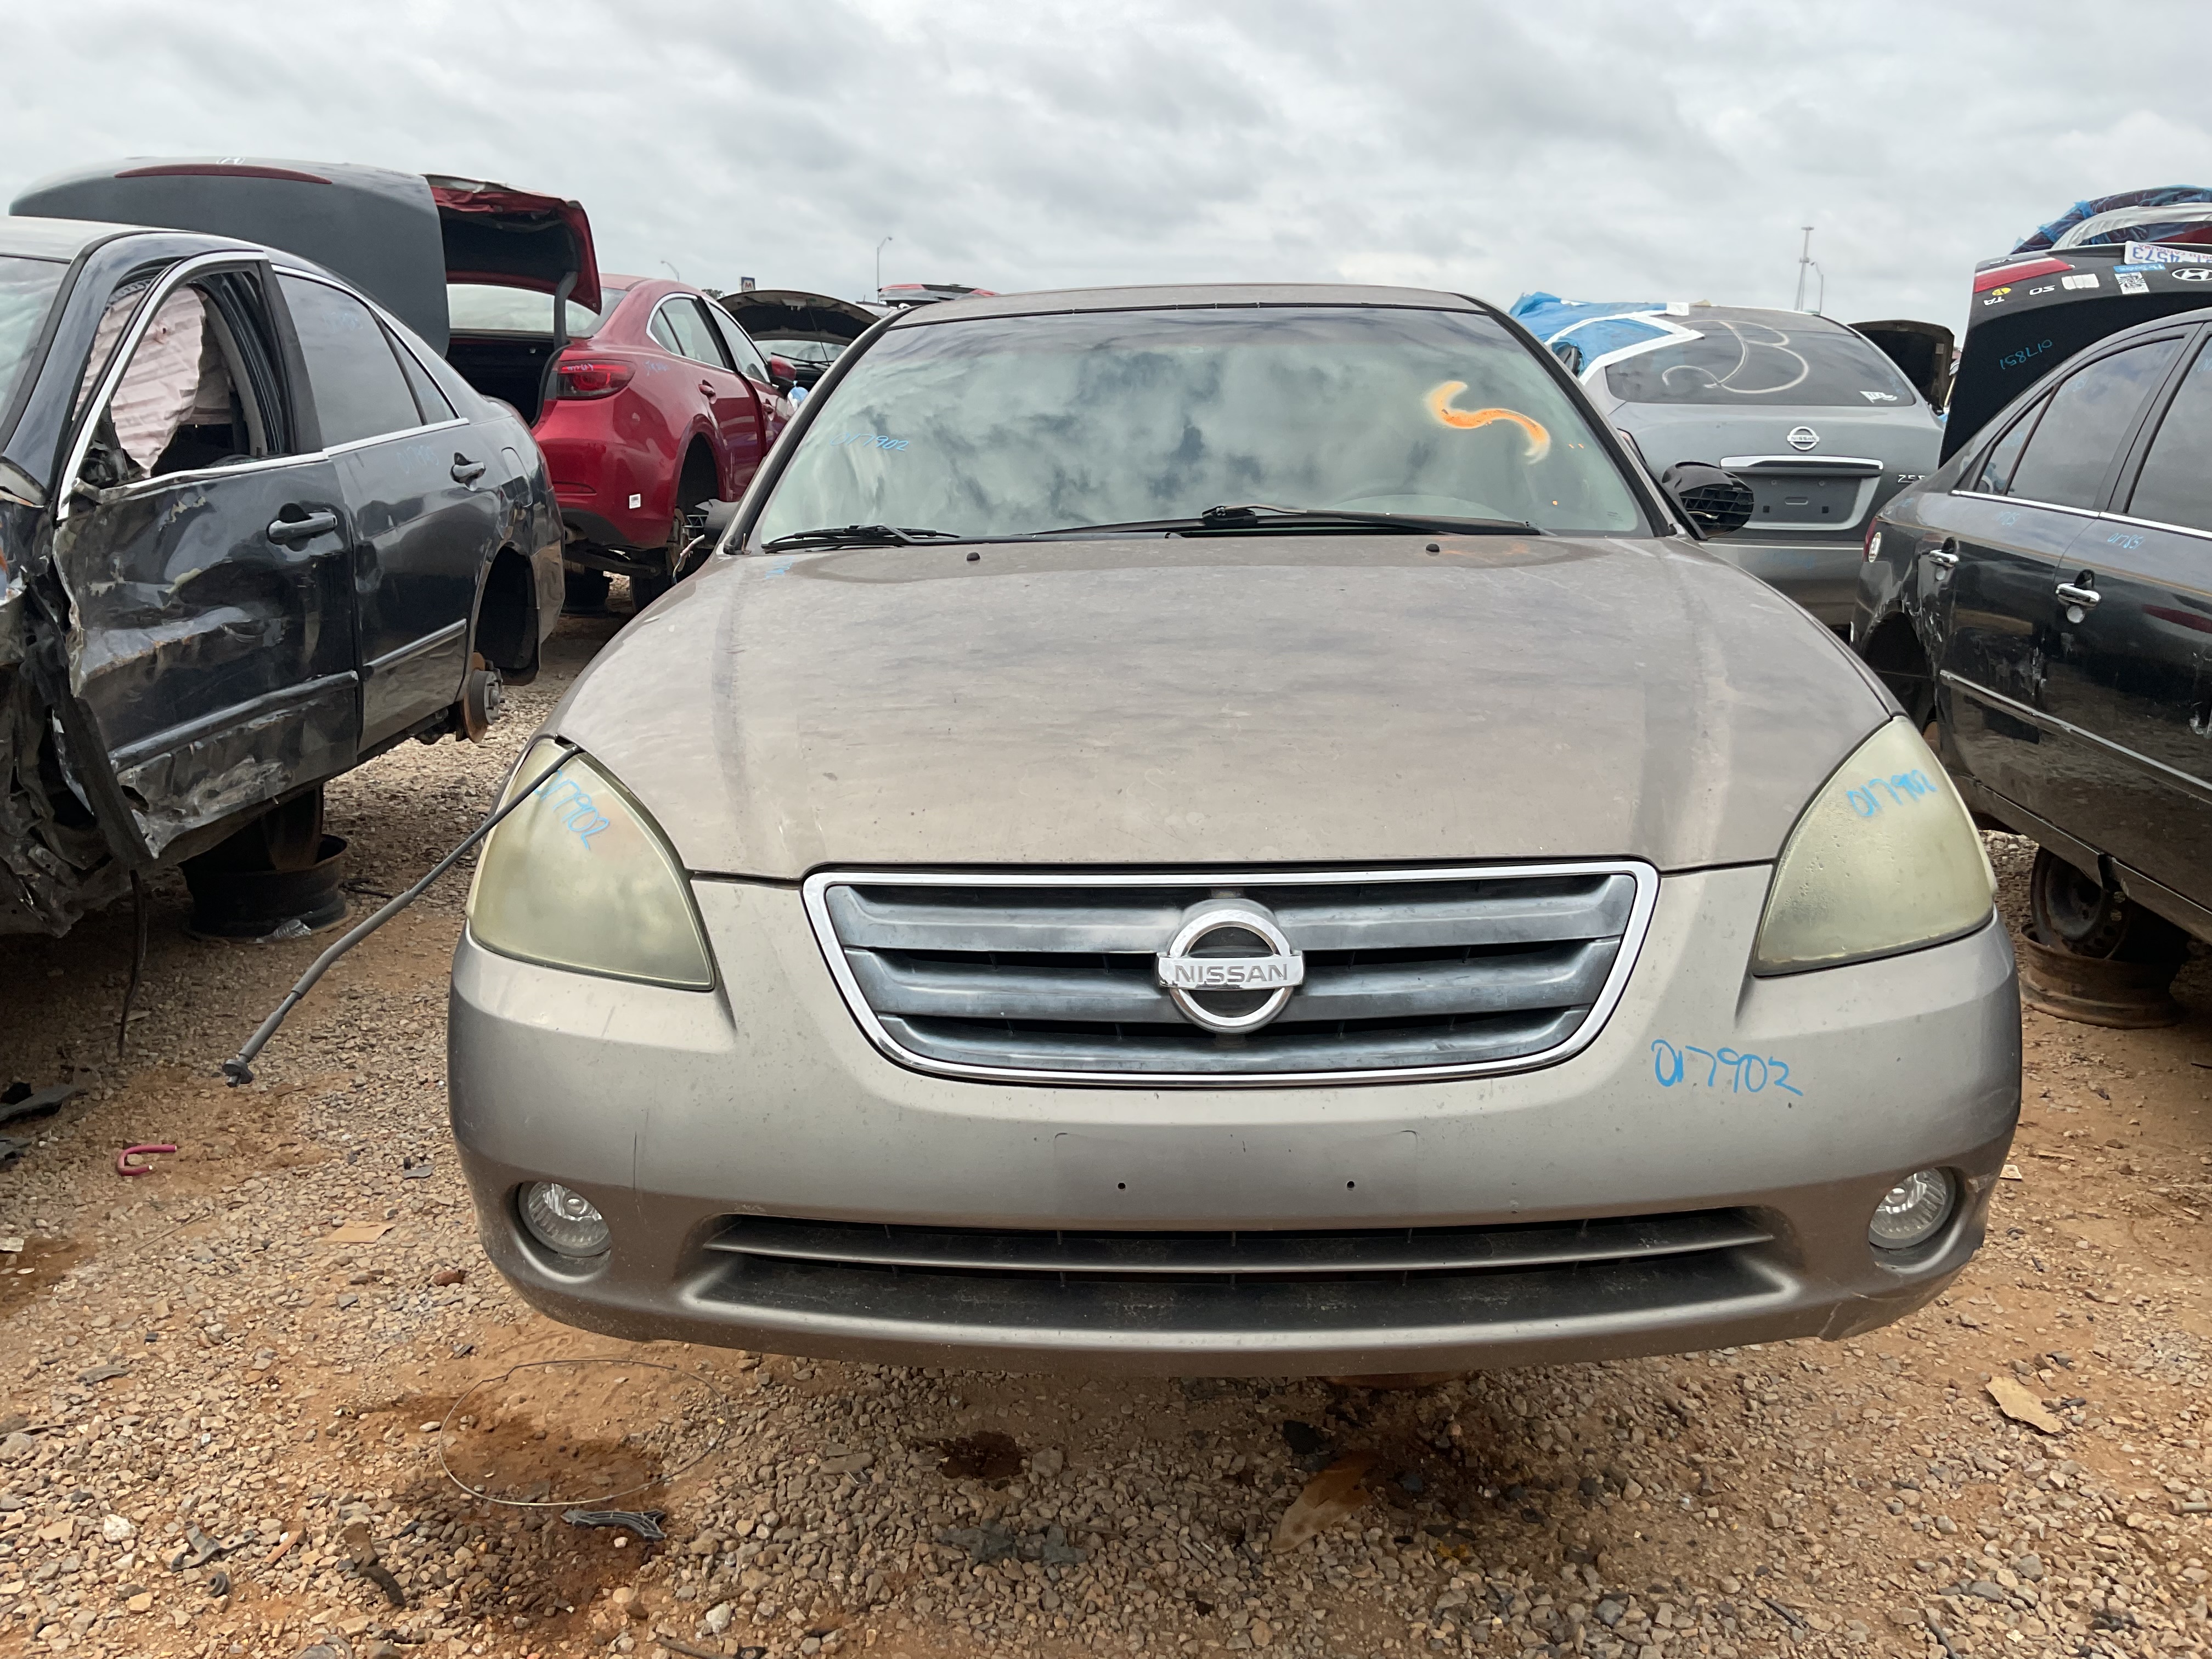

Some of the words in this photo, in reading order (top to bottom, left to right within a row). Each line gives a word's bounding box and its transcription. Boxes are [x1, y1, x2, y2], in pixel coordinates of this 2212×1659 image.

[1999, 338, 2053, 370] 017851
[830, 431, 909, 452] 017902
[1174, 963, 1288, 983] NISSAN
[1650, 1039, 1804, 1096] 017902
